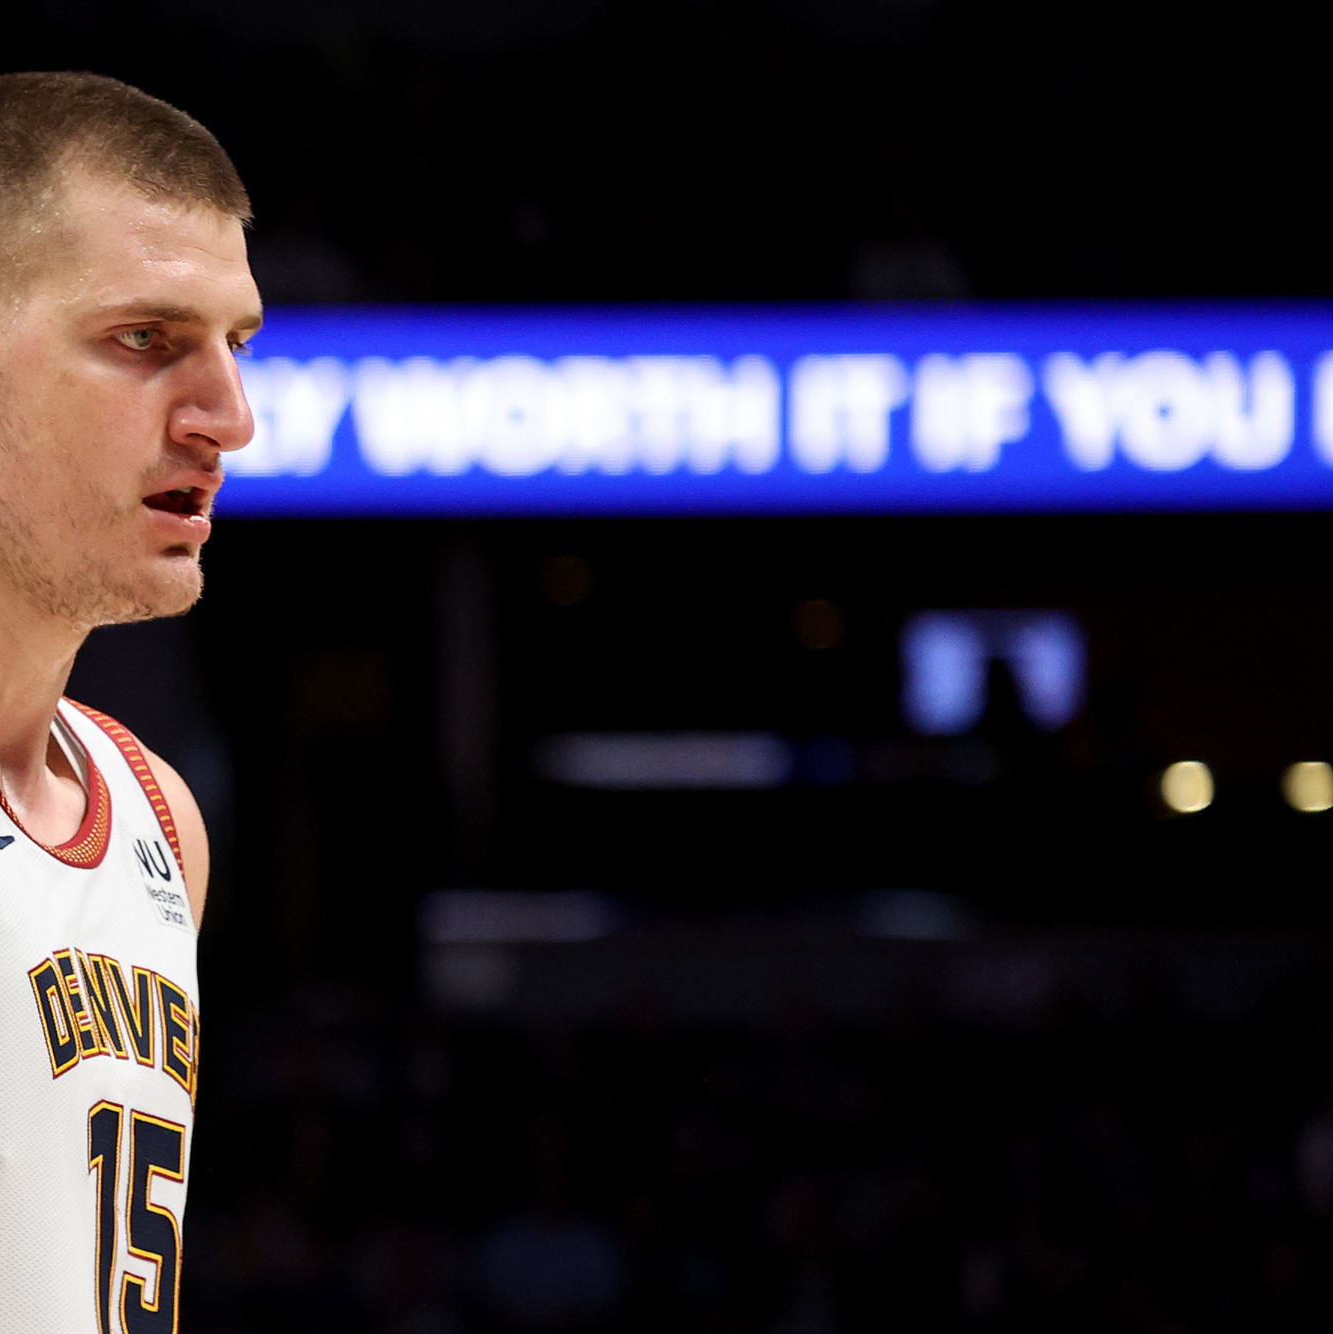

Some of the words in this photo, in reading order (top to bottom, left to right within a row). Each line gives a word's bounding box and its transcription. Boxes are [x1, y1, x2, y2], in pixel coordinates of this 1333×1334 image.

[351, 355, 783, 478] WORTH
[787, 353, 911, 475] IT
[911, 352, 1033, 474] IF
[1041, 349, 1296, 473] YOU
